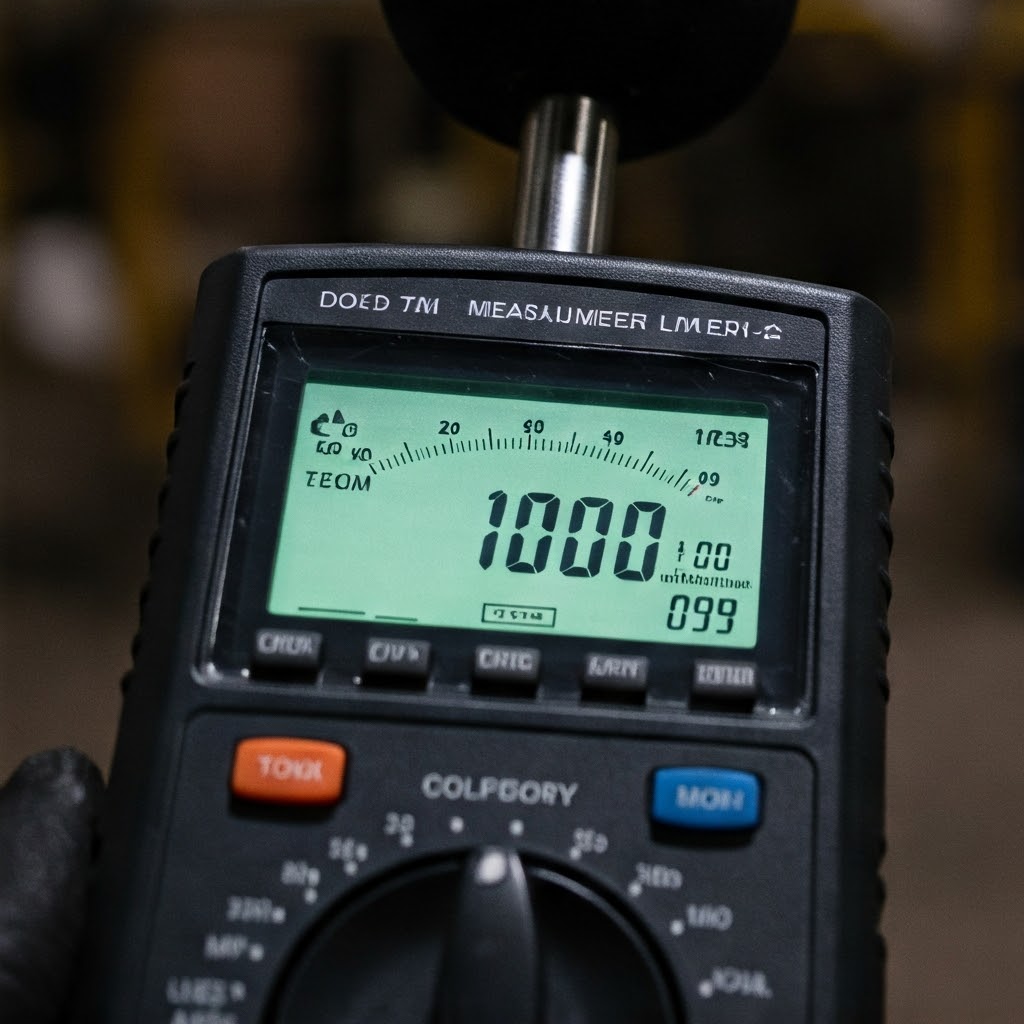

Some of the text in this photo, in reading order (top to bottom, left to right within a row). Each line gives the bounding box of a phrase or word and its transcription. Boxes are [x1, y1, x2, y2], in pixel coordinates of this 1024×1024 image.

[438, 420, 461, 435] 20
[479, 490, 666, 582] 1000
[667, 594, 738, 634] 099
